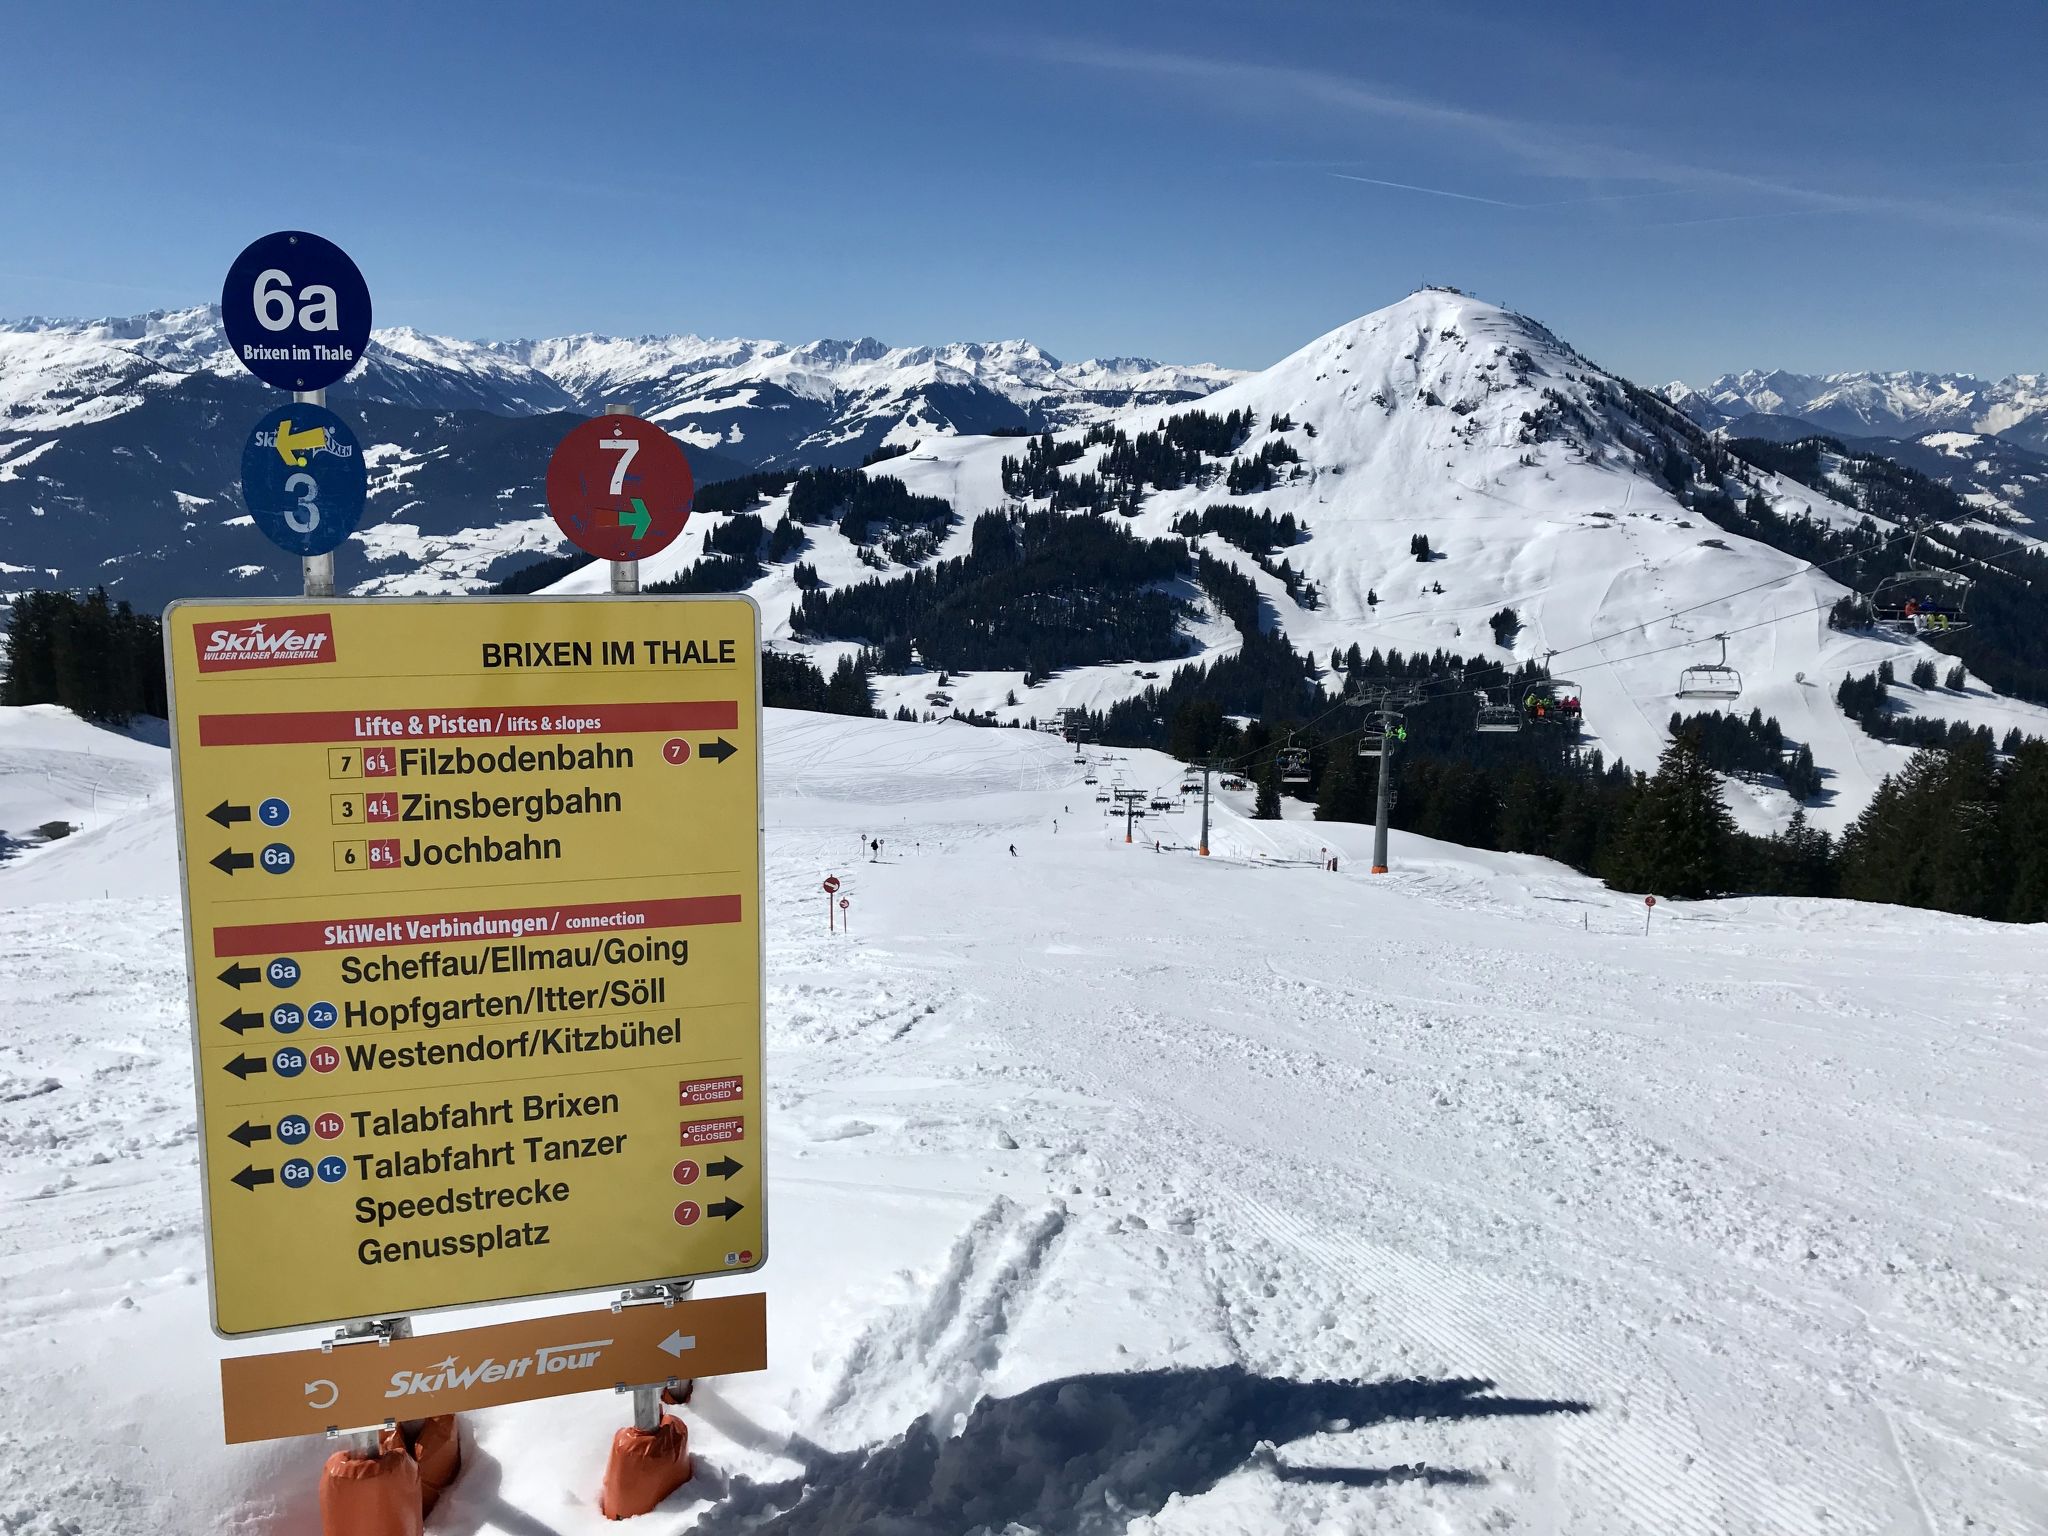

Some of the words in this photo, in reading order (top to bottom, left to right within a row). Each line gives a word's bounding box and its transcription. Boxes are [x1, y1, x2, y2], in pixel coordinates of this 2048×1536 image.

[253, 268, 339, 332] 6a
[243, 344, 290, 360] Brixen
[292, 344, 311, 360] im
[313, 345, 353, 361] Thale
[599, 439, 640, 495] 7
[284, 472, 321, 533] 3
[203, 651, 237, 661] WILDER
[238, 651, 271, 660] KAISER
[273, 650, 318, 659] BRIXENTAL
[205, 629, 327, 653] SkiWelt
[482, 641, 593, 668] BRIXEN
[602, 641, 635, 666] IM
[643, 639, 736, 665] THALE
[355, 716, 403, 737] Lifte
[407, 715, 424, 734] &
[428, 714, 492, 735] Pisten
[495, 713, 504, 734] /
[507, 716, 538, 732] lifts
[540, 716, 553, 731] &
[555, 715, 602, 734] slopes
[341, 756, 352, 772] 7
[366, 755, 376, 771] 6
[400, 743, 634, 777] Filzbodenbahn
[671, 745, 681, 758] 7
[268, 806, 278, 819] 3
[342, 801, 353, 818] 3
[368, 800, 379, 815] 4
[401, 786, 622, 822] Zinsbergbahn
[264, 848, 291, 865] 6a
[344, 848, 356, 864] 6
[370, 847, 381, 862] 8
[403, 833, 562, 867] Jochbahn
[324, 921, 402, 945] SkiWelt
[406, 915, 548, 940] Verbindungen
[551, 912, 560, 931] /
[565, 911, 645, 929] connection
[270, 963, 296, 980] 6a
[341, 936, 689, 984] Scheffau/Ellmau/Going
[274, 1008, 300, 1025] 6a
[313, 1010, 333, 1022] 2a
[345, 977, 665, 1031] Hopfgarten/Itter/Söll
[276, 1052, 302, 1069] 6a
[316, 1053, 335, 1065] 1b
[345, 1018, 681, 1072] Westendorf/Kitzbühel
[686, 1080, 737, 1093] GESPERRT
[692, 1090, 731, 1101] CLOSED
[280, 1120, 306, 1137] 6a
[320, 1120, 339, 1132] 1b
[351, 1100, 513, 1138] Talabfahrt
[523, 1092, 619, 1122] Brixen
[687, 1121, 738, 1134] GESPERRT
[693, 1131, 732, 1142] CLOSED
[284, 1164, 310, 1180] 6a
[323, 1164, 341, 1176] 1c
[353, 1142, 515, 1180] Talabfahrt
[523, 1133, 627, 1163] Tanzer
[682, 1167, 691, 1178] 7
[355, 1178, 570, 1228] Speedstrecke
[683, 1208, 692, 1219] 7
[358, 1222, 550, 1266] Genussplatz
[384, 1357, 533, 1398] SkiWelt
[536, 1339, 614, 1376] Tour
